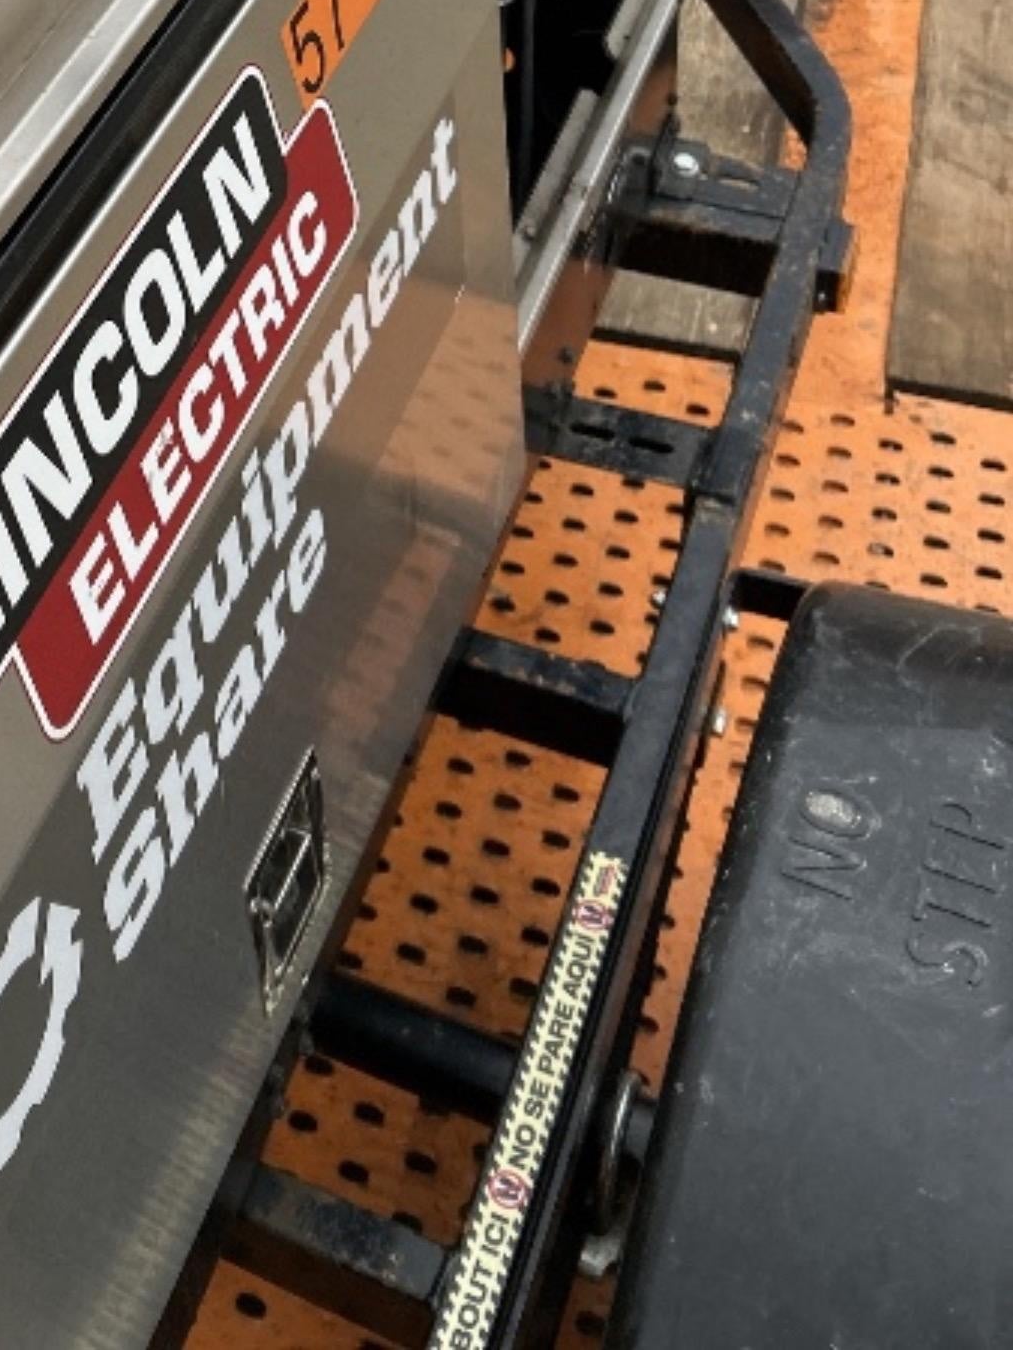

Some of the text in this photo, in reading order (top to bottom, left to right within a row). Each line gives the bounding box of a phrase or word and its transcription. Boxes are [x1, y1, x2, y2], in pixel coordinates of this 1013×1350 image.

[68, 190, 327, 646] ELECTRIC
[76, 119, 458, 864] Equipment
[104, 508, 328, 962] Share
[781, 787, 876, 901] NO
[509, 934, 598, 1170] NO SE PARE AQUI
[482, 1211, 510, 1257] ICI
